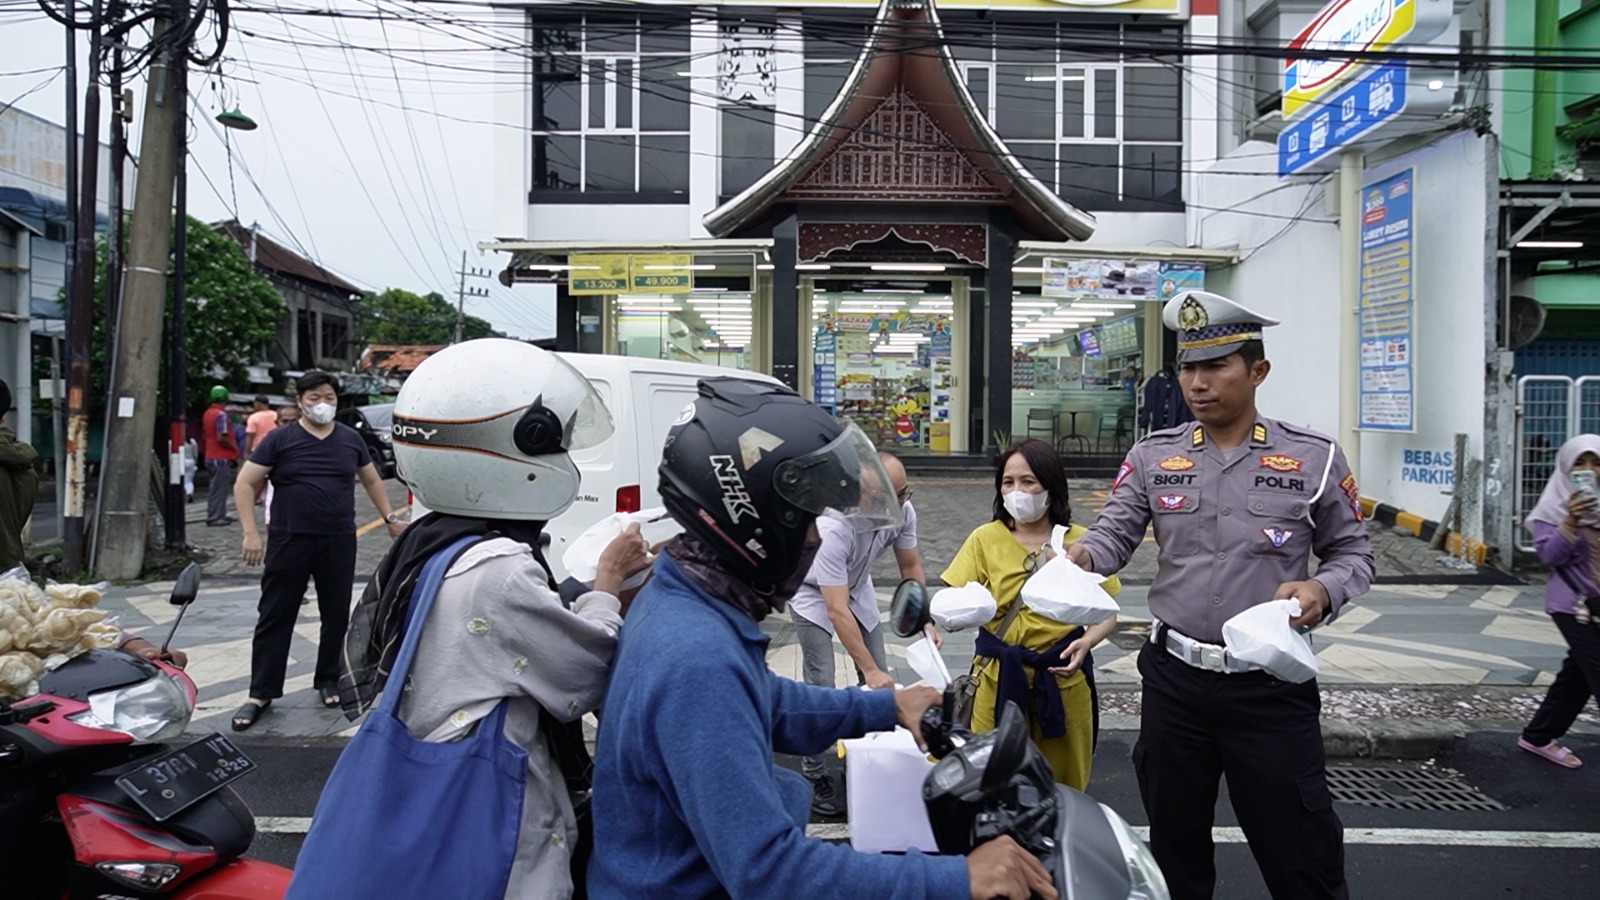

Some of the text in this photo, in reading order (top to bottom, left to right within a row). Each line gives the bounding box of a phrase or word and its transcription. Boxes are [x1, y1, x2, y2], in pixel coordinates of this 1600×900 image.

[584, 281, 617, 289] 13.200
[645, 277, 679, 286] 49.900
[1404, 449, 1453, 466] BEBAS
[1153, 474, 1198, 486] SIGIT
[1254, 475, 1304, 492] POLRI
[1402, 467, 1457, 485] PARKIR
[709, 455, 760, 525] NHK
[121, 778, 148, 797] L
[206, 736, 235, 757] VT
